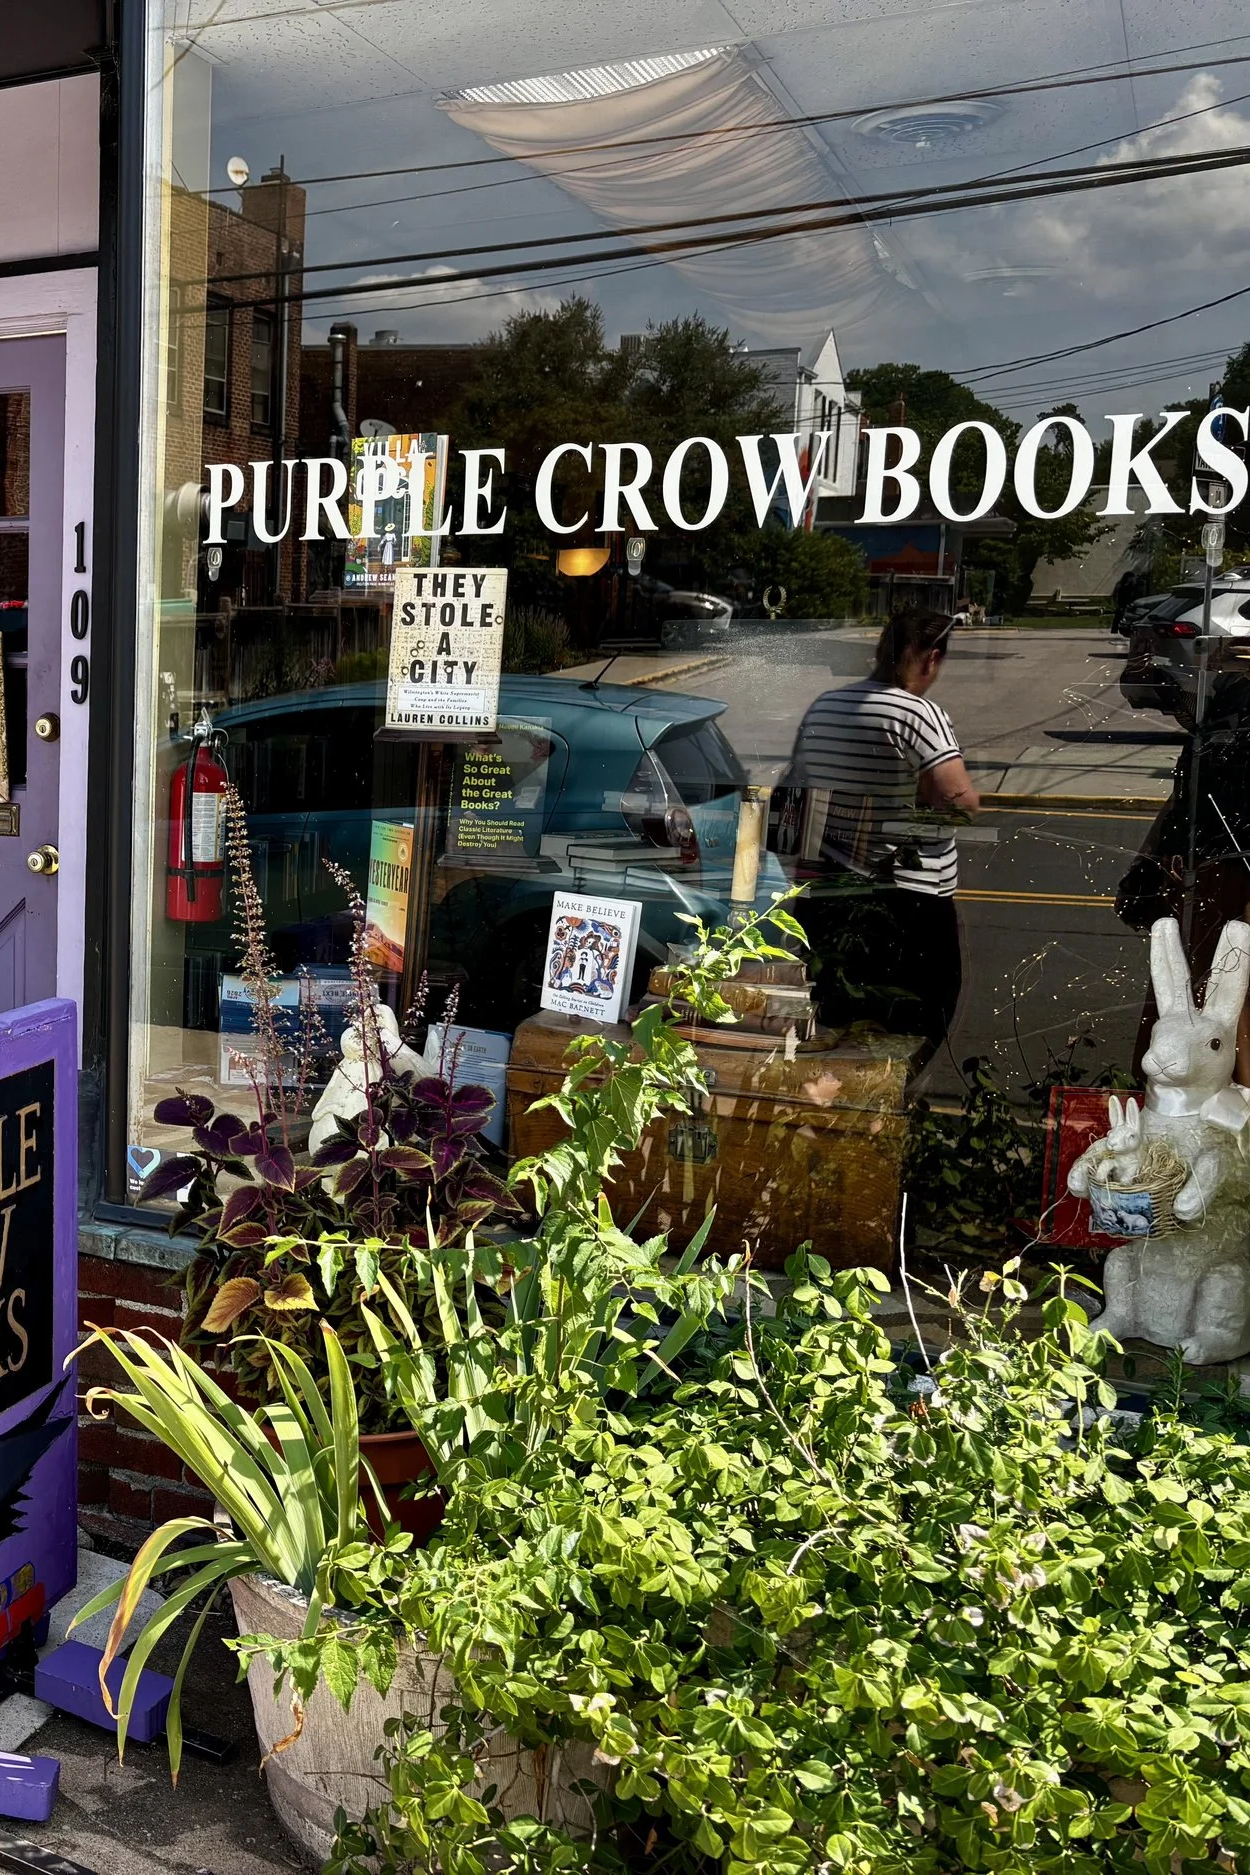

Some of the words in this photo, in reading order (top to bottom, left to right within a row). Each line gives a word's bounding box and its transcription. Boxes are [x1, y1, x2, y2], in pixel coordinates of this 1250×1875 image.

[203, 447, 508, 545] PURPLE
[535, 431, 833, 535] CROW
[853, 405, 1250, 524] BOOKS
[352, 573, 378, 582] ANDREW
[413, 573, 487, 598] THEY
[69, 521, 90, 705] 109
[400, 601, 494, 628] STOLE
[436, 631, 452, 656] A
[409, 659, 478, 685] CITY
[390, 713, 434, 725] LAUREN
[439, 714, 489, 726] COLLINS
[464, 752, 502, 762] What's
[463, 764, 478, 774] So
[480, 764, 511, 775] Great
[462, 776, 496, 786] About
[461, 788, 480, 798] the
[481, 788, 513, 799] Great
[460, 800, 500, 810] Books?
[457, 840, 482, 849] Destroy
[477, 833, 500, 842] Though
[505, 835, 524, 843] Might
[368, 859, 410, 894] YESTERYEAR
[556, 900, 583, 912] MAKE
[586, 904, 626, 919] BELIEVE
[550, 998, 568, 1008] MAC
[569, 1002, 606, 1016] BARNETT
